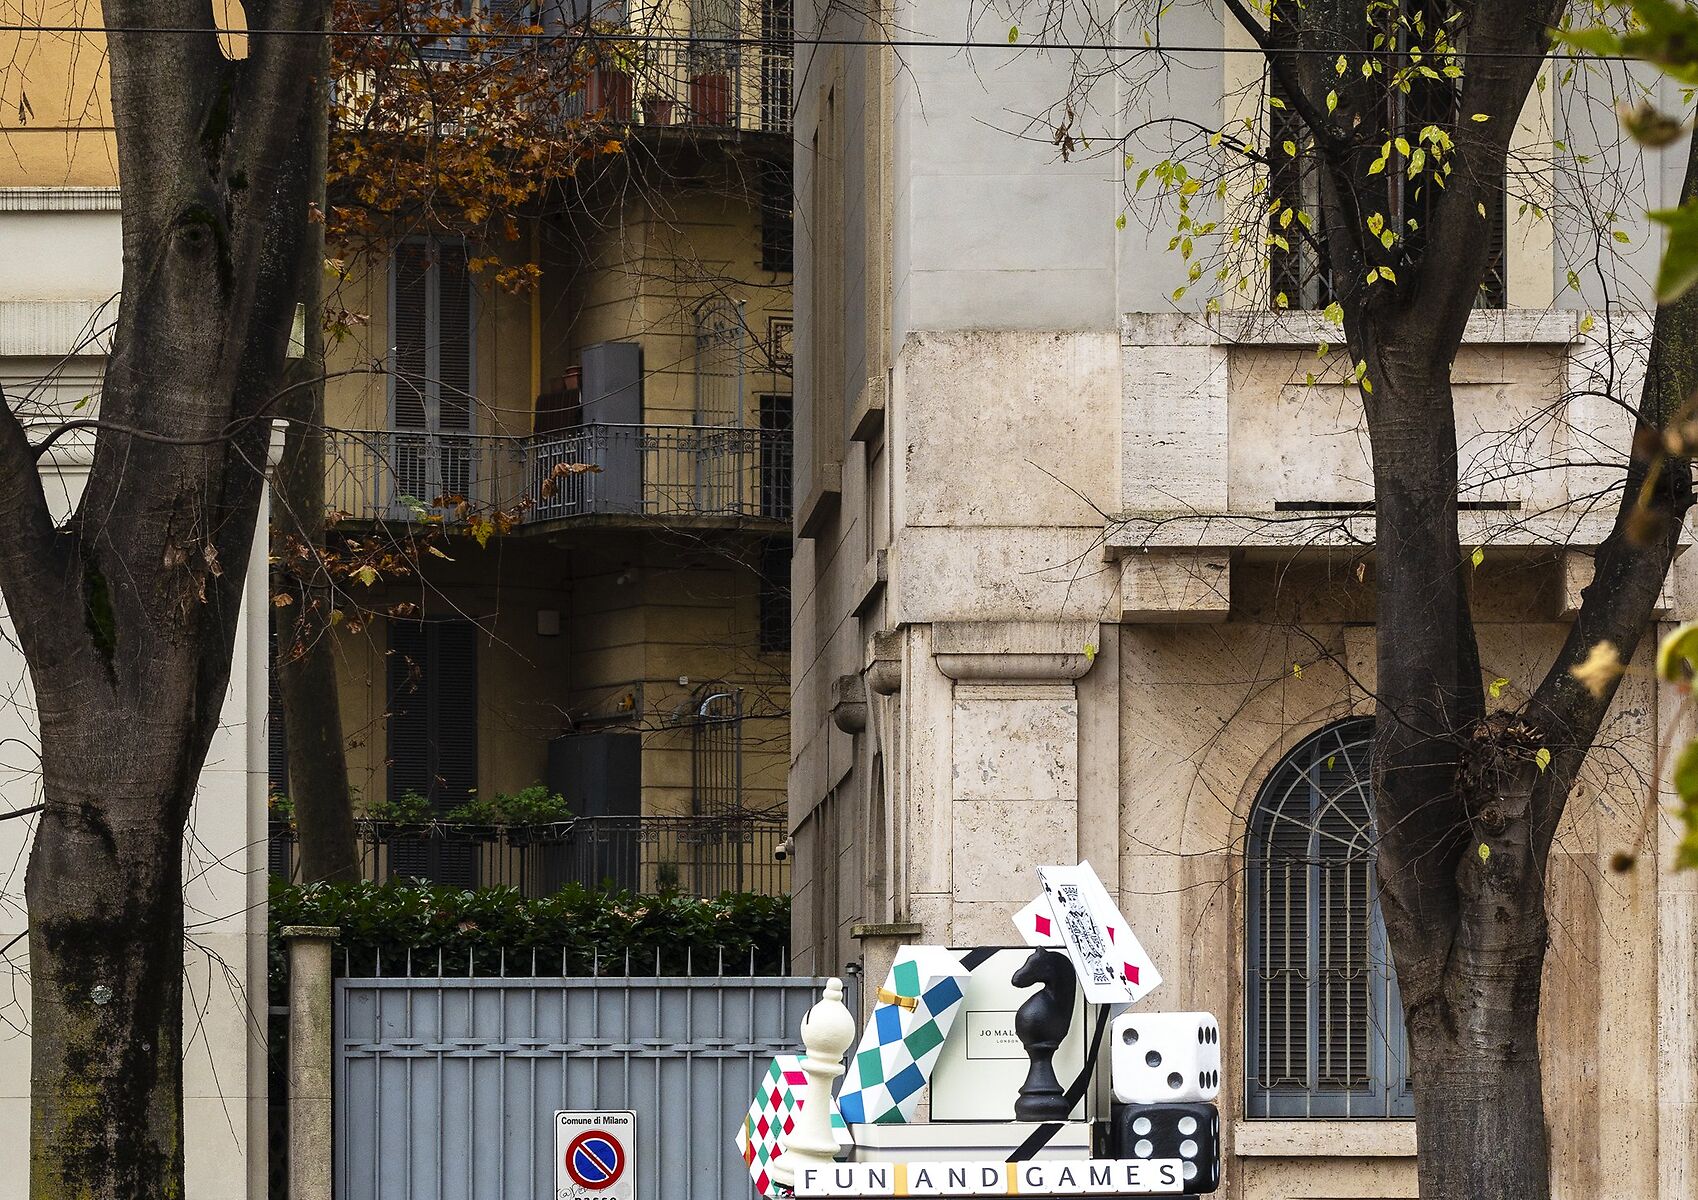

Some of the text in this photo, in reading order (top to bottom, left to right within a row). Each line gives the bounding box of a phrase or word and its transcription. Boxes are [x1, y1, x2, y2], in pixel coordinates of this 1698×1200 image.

[561, 1116, 628, 1125] Comune di Milano
[805, 1164, 1176, 1189] FUN AND GAMES
